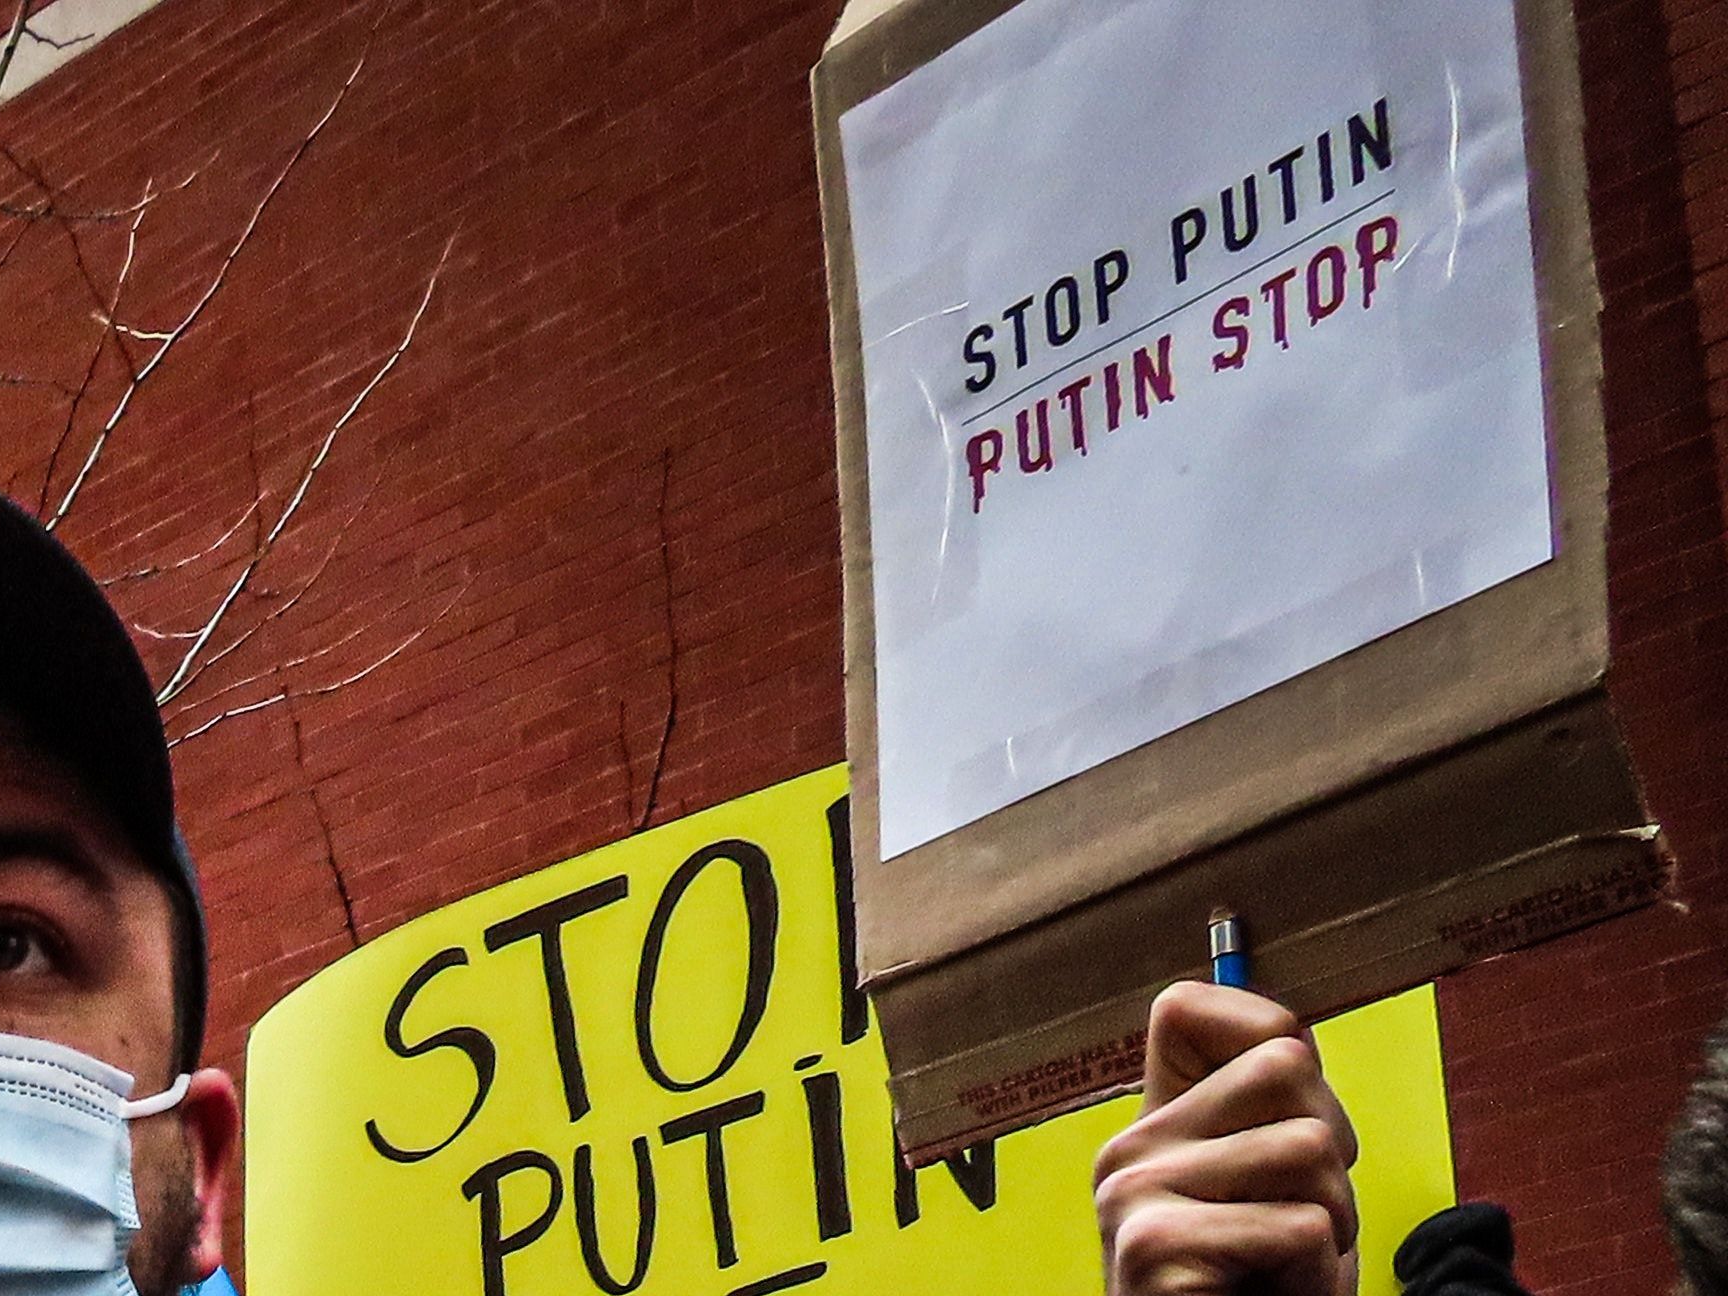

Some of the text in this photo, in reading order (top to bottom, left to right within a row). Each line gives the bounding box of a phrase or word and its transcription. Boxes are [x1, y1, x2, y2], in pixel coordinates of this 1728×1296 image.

[962, 97, 1395, 395] STOP PUTIN
[965, 214, 1400, 515] PUTIN STOP
